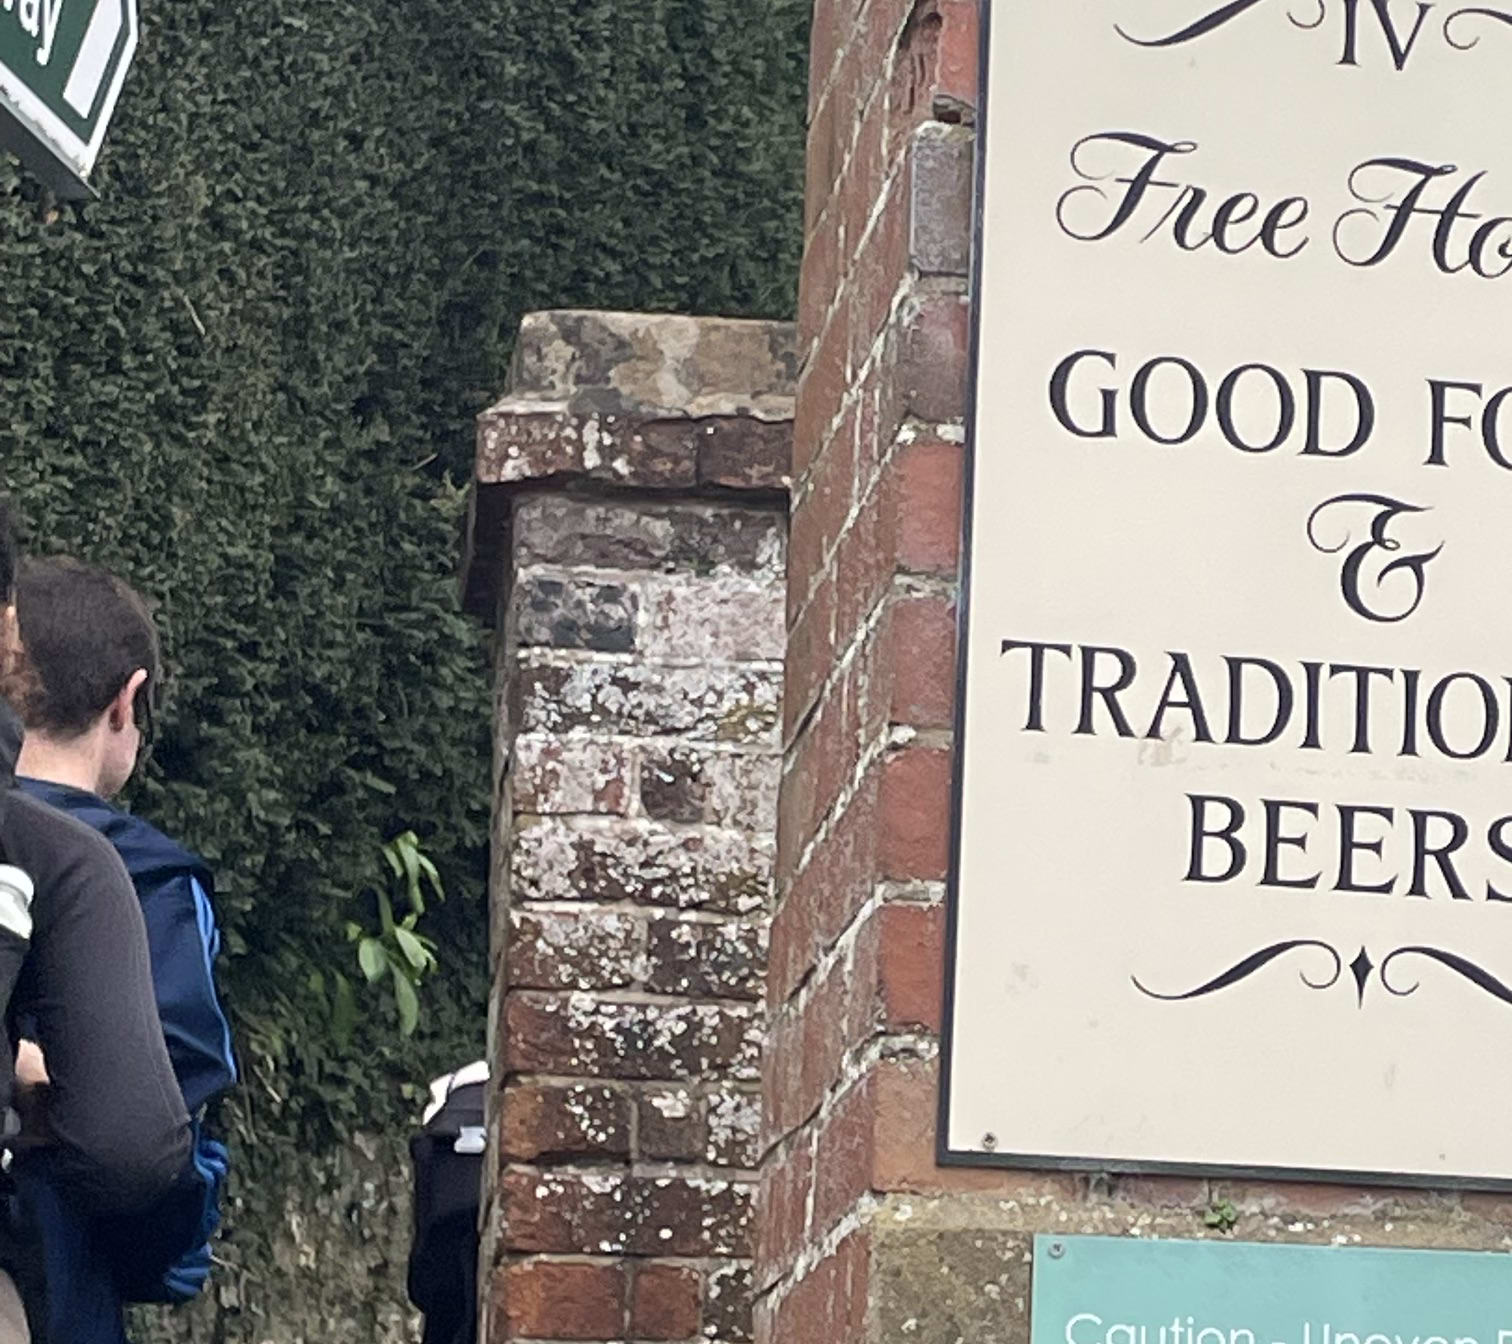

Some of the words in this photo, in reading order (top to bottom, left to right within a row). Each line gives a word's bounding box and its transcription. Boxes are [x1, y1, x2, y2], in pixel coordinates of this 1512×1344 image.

[1055, 132, 1310, 259] Free
[1048, 349, 1375, 457] GOOD
[1306, 493, 1444, 623] &
